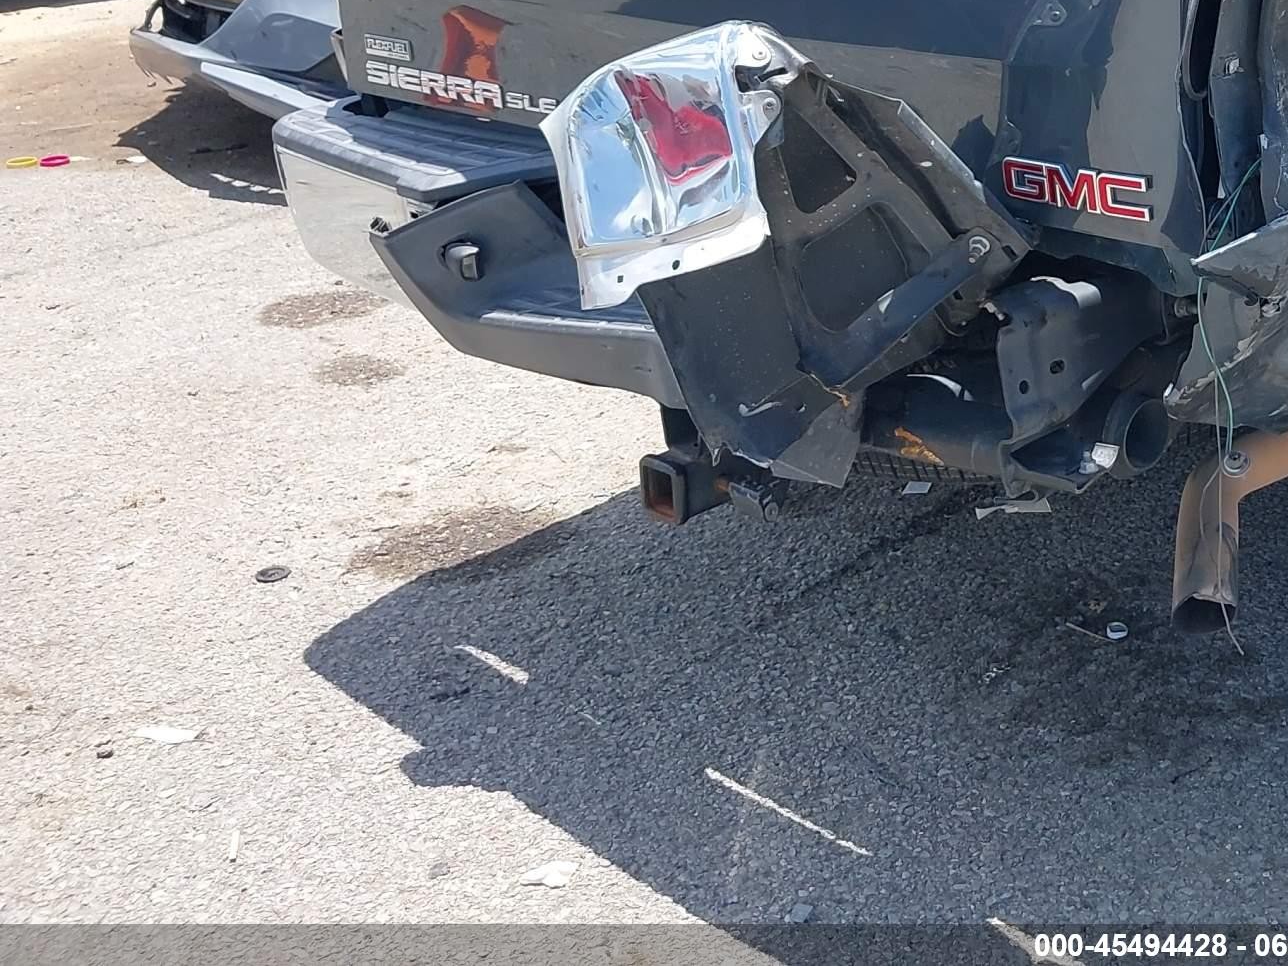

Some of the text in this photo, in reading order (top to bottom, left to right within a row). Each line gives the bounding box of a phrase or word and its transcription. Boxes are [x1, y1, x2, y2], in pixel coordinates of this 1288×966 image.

[366, 38, 408, 54] FLEXFUEL
[366, 60, 557, 114] SIERRA SLE
[1002, 156, 1152, 222] GMC
